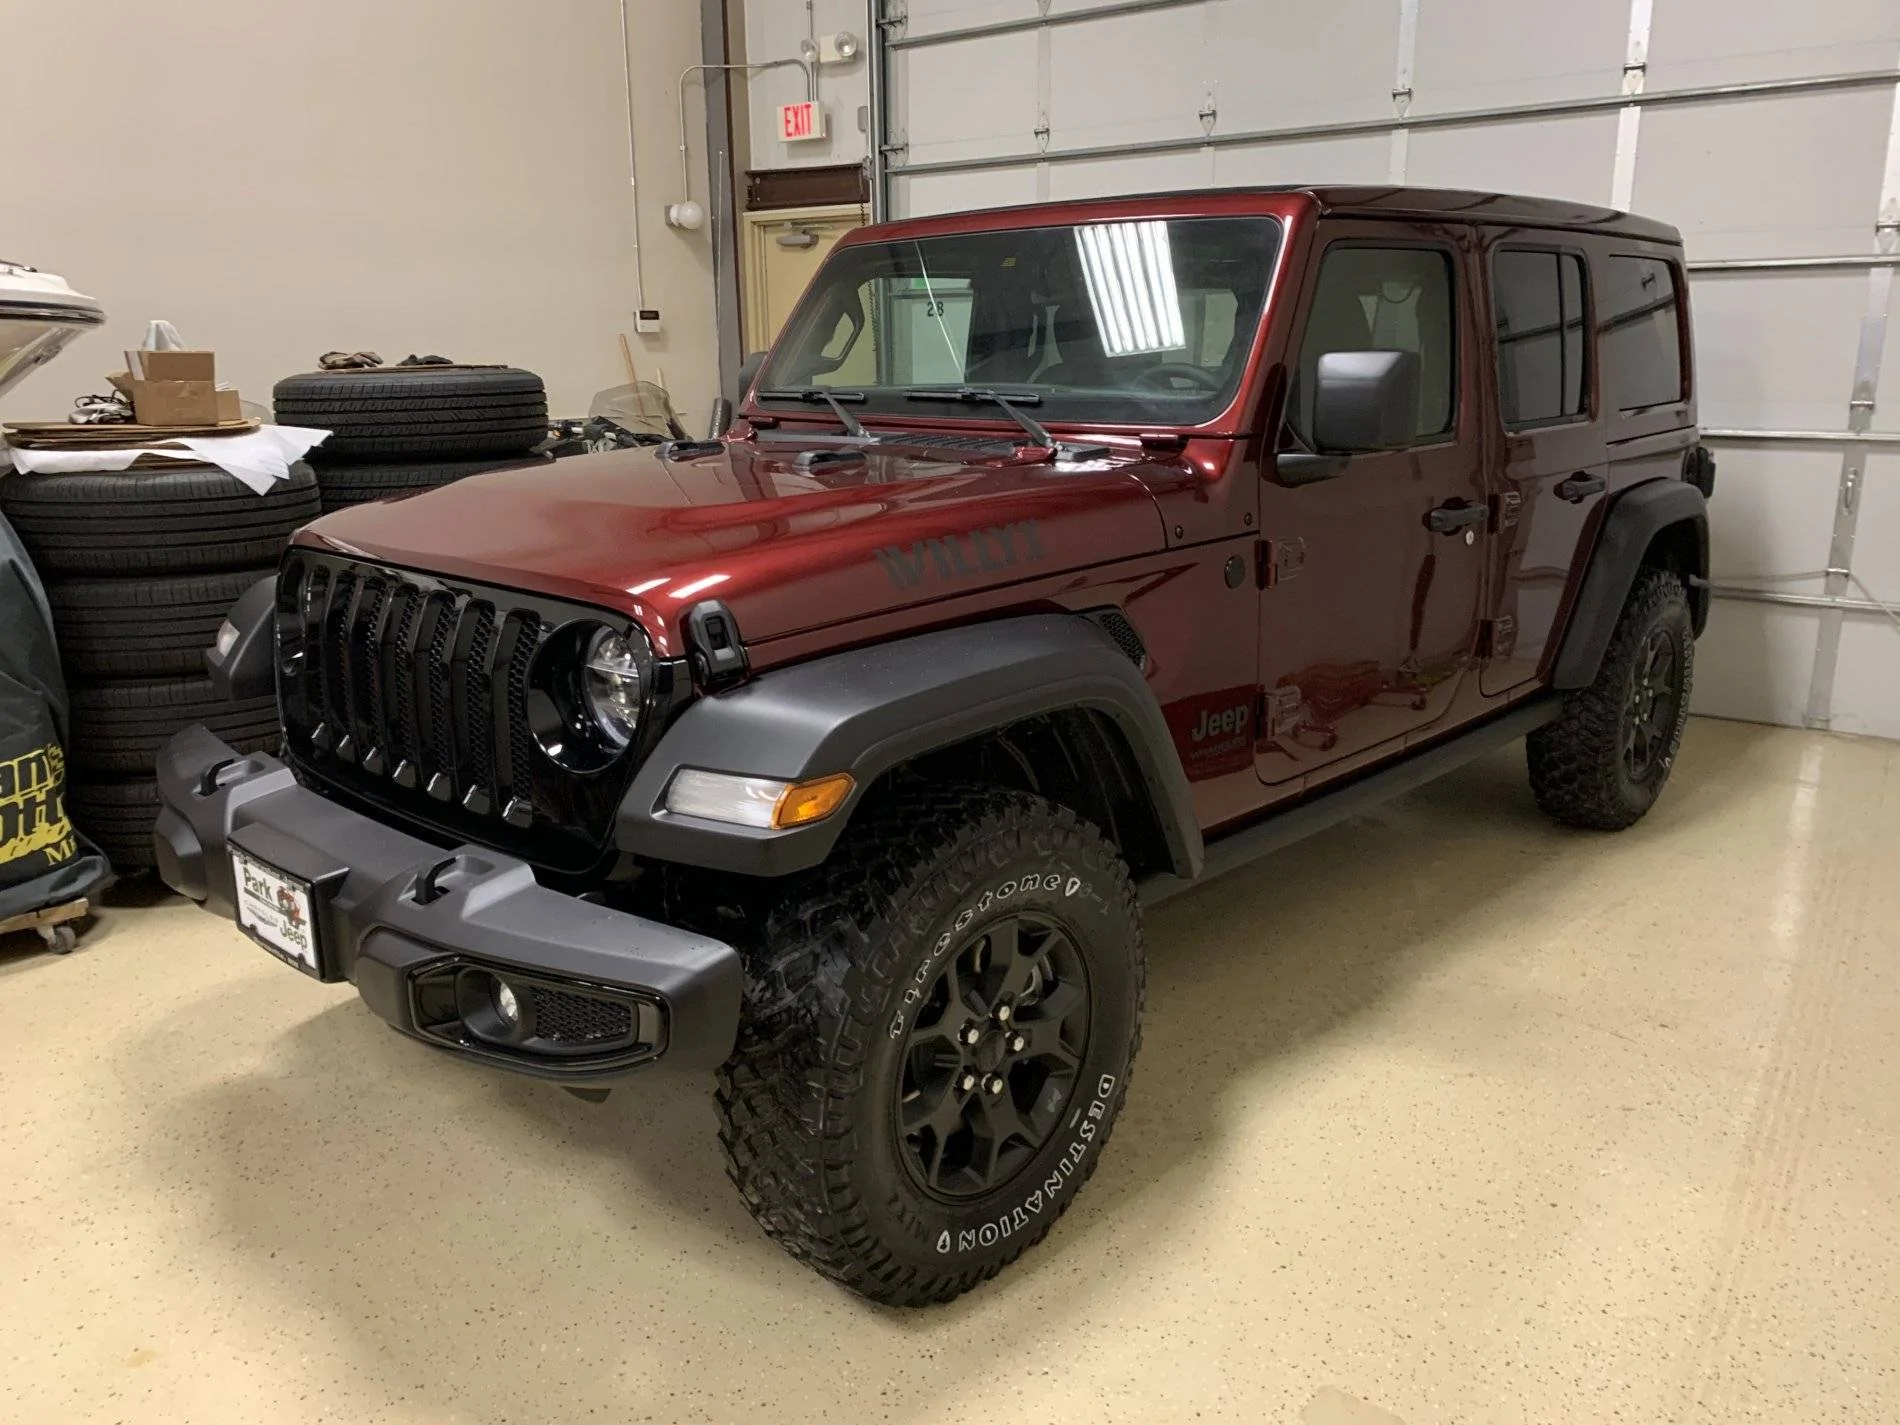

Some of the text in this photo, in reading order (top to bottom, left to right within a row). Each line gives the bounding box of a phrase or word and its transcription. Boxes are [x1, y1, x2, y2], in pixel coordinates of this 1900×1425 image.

[784, 103, 812, 138] EXIT
[927, 301, 944, 317] 28
[1191, 704, 1249, 742] Jeep
[243, 866, 273, 902] Park
[279, 919, 308, 950] Jeep
[889, 872, 1062, 1039] Firestone
[958, 1074, 1116, 1252] DESTINATION
